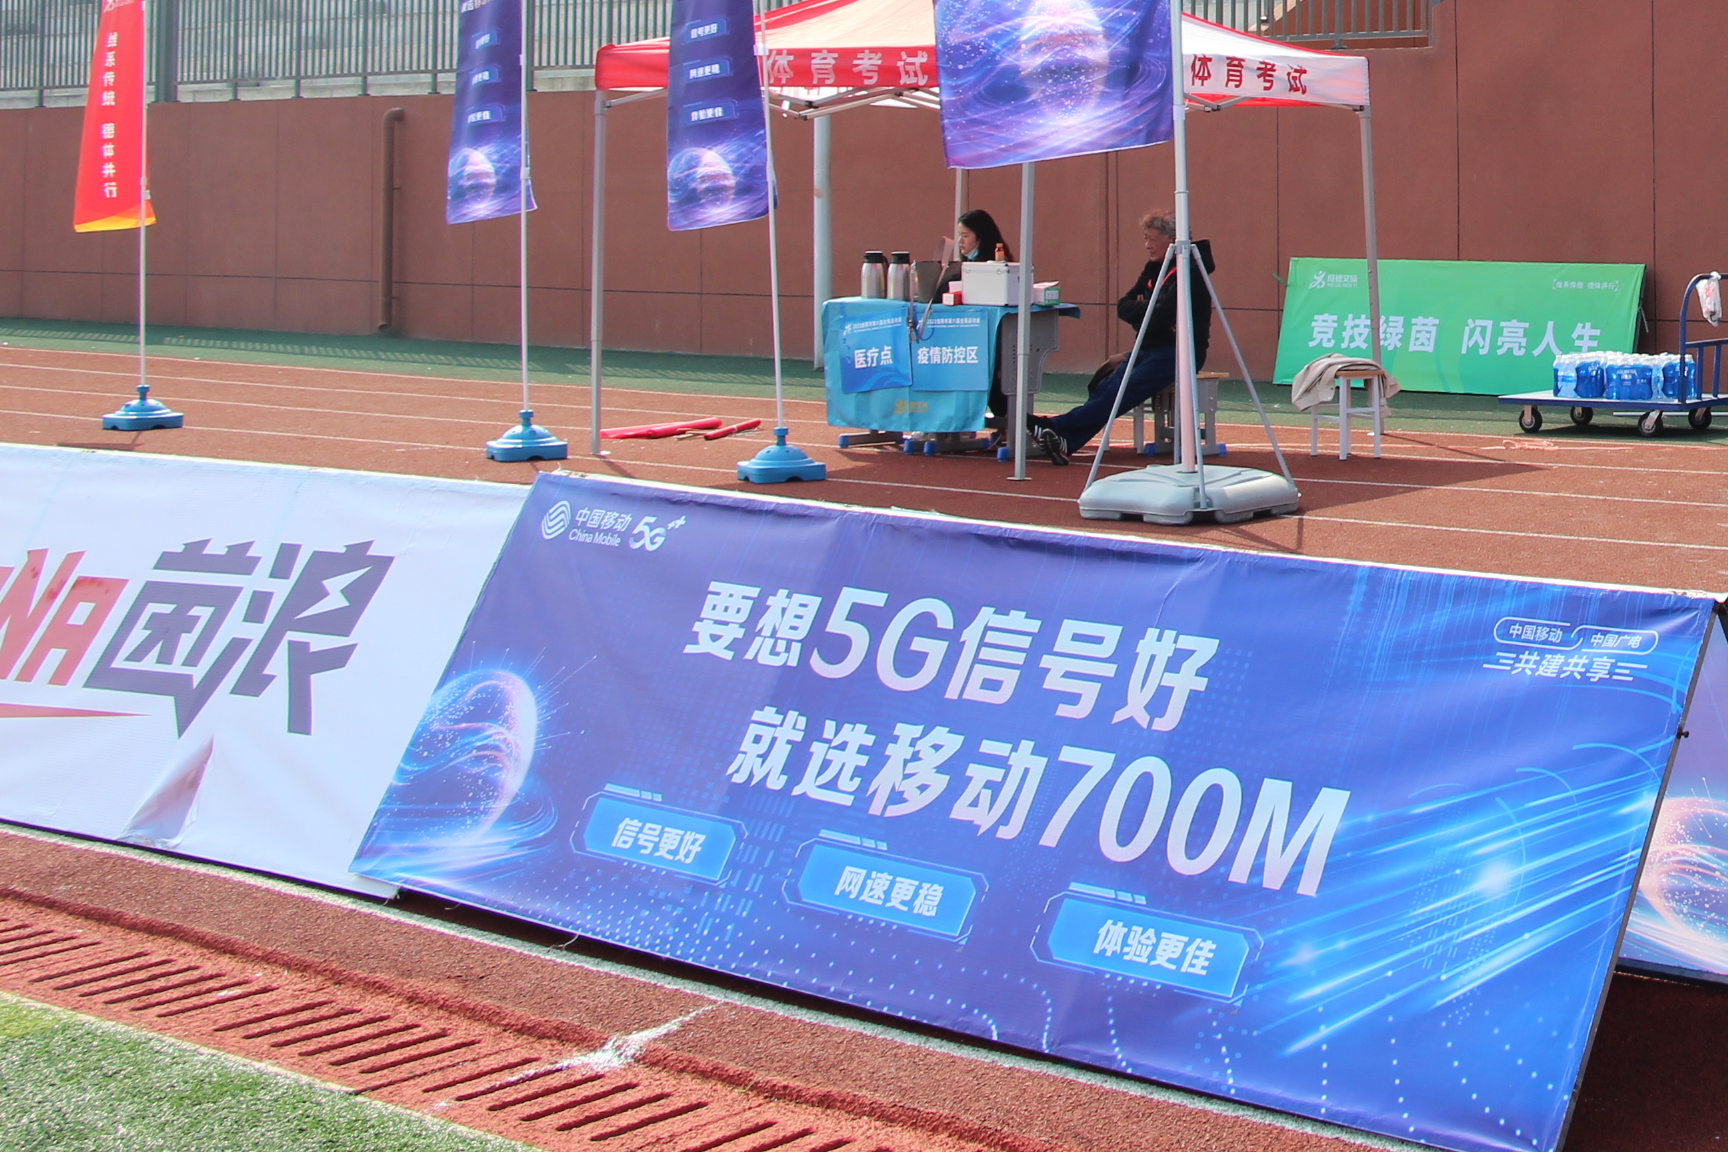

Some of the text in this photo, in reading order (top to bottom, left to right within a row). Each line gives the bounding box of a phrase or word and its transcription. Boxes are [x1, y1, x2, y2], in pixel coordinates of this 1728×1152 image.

[767, 49, 929, 86] 体育考试
[1191, 54, 1308, 95] 体育考试
[917, 346, 979, 364] 疫情防控区
[1308, 313, 1601, 357] 竞技绿茵 闪亮人生
[854, 345, 893, 369] 医疗点
[569, 528, 621, 547] China Mobile
[575, 507, 633, 532] 中国移动
[0, 548, 130, 686] NA
[1508, 623, 1643, 649] 中国移动 中国广电
[683, 580, 1220, 733] 要想5G信号好
[1511, 650, 1617, 682] 共建共享
[726, 706, 1351, 898] 就选移动700M
[611, 816, 706, 864] 信号更好
[833, 864, 944, 917] 网速更稳
[1095, 918, 1218, 977] 体验更佳
